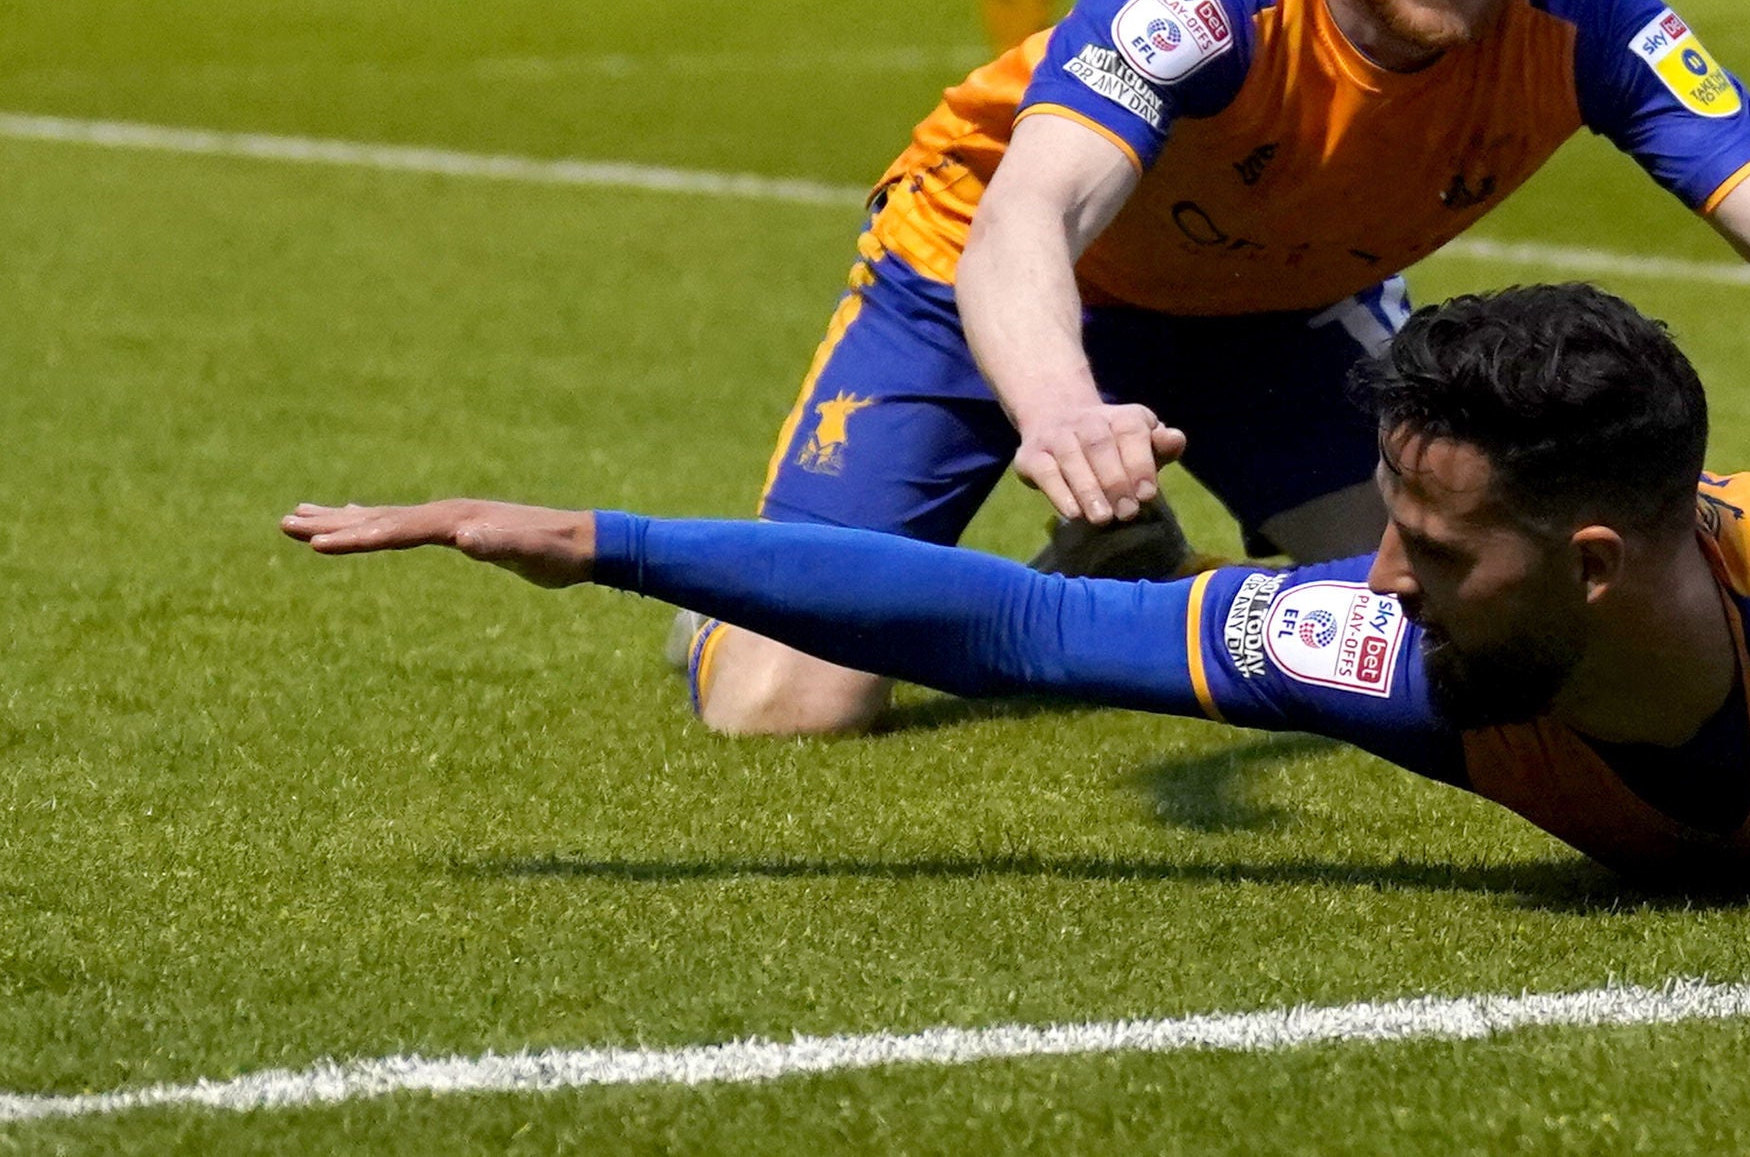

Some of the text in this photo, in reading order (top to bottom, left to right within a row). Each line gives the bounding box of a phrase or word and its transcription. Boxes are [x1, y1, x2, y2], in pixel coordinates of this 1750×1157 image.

[1200, 2, 1226, 38] bet
[1079, 44, 1118, 71] NOT
[1132, 36, 1156, 64] EFL
[1643, 30, 1668, 55] sky
[1069, 62, 1157, 123] OR ANY DAY
[1228, 595, 1251, 631] ANY
[1278, 609, 1299, 638] EFL
[1339, 594, 1369, 677] PLAY-OFFS
[1362, 600, 1395, 680] sky bet
